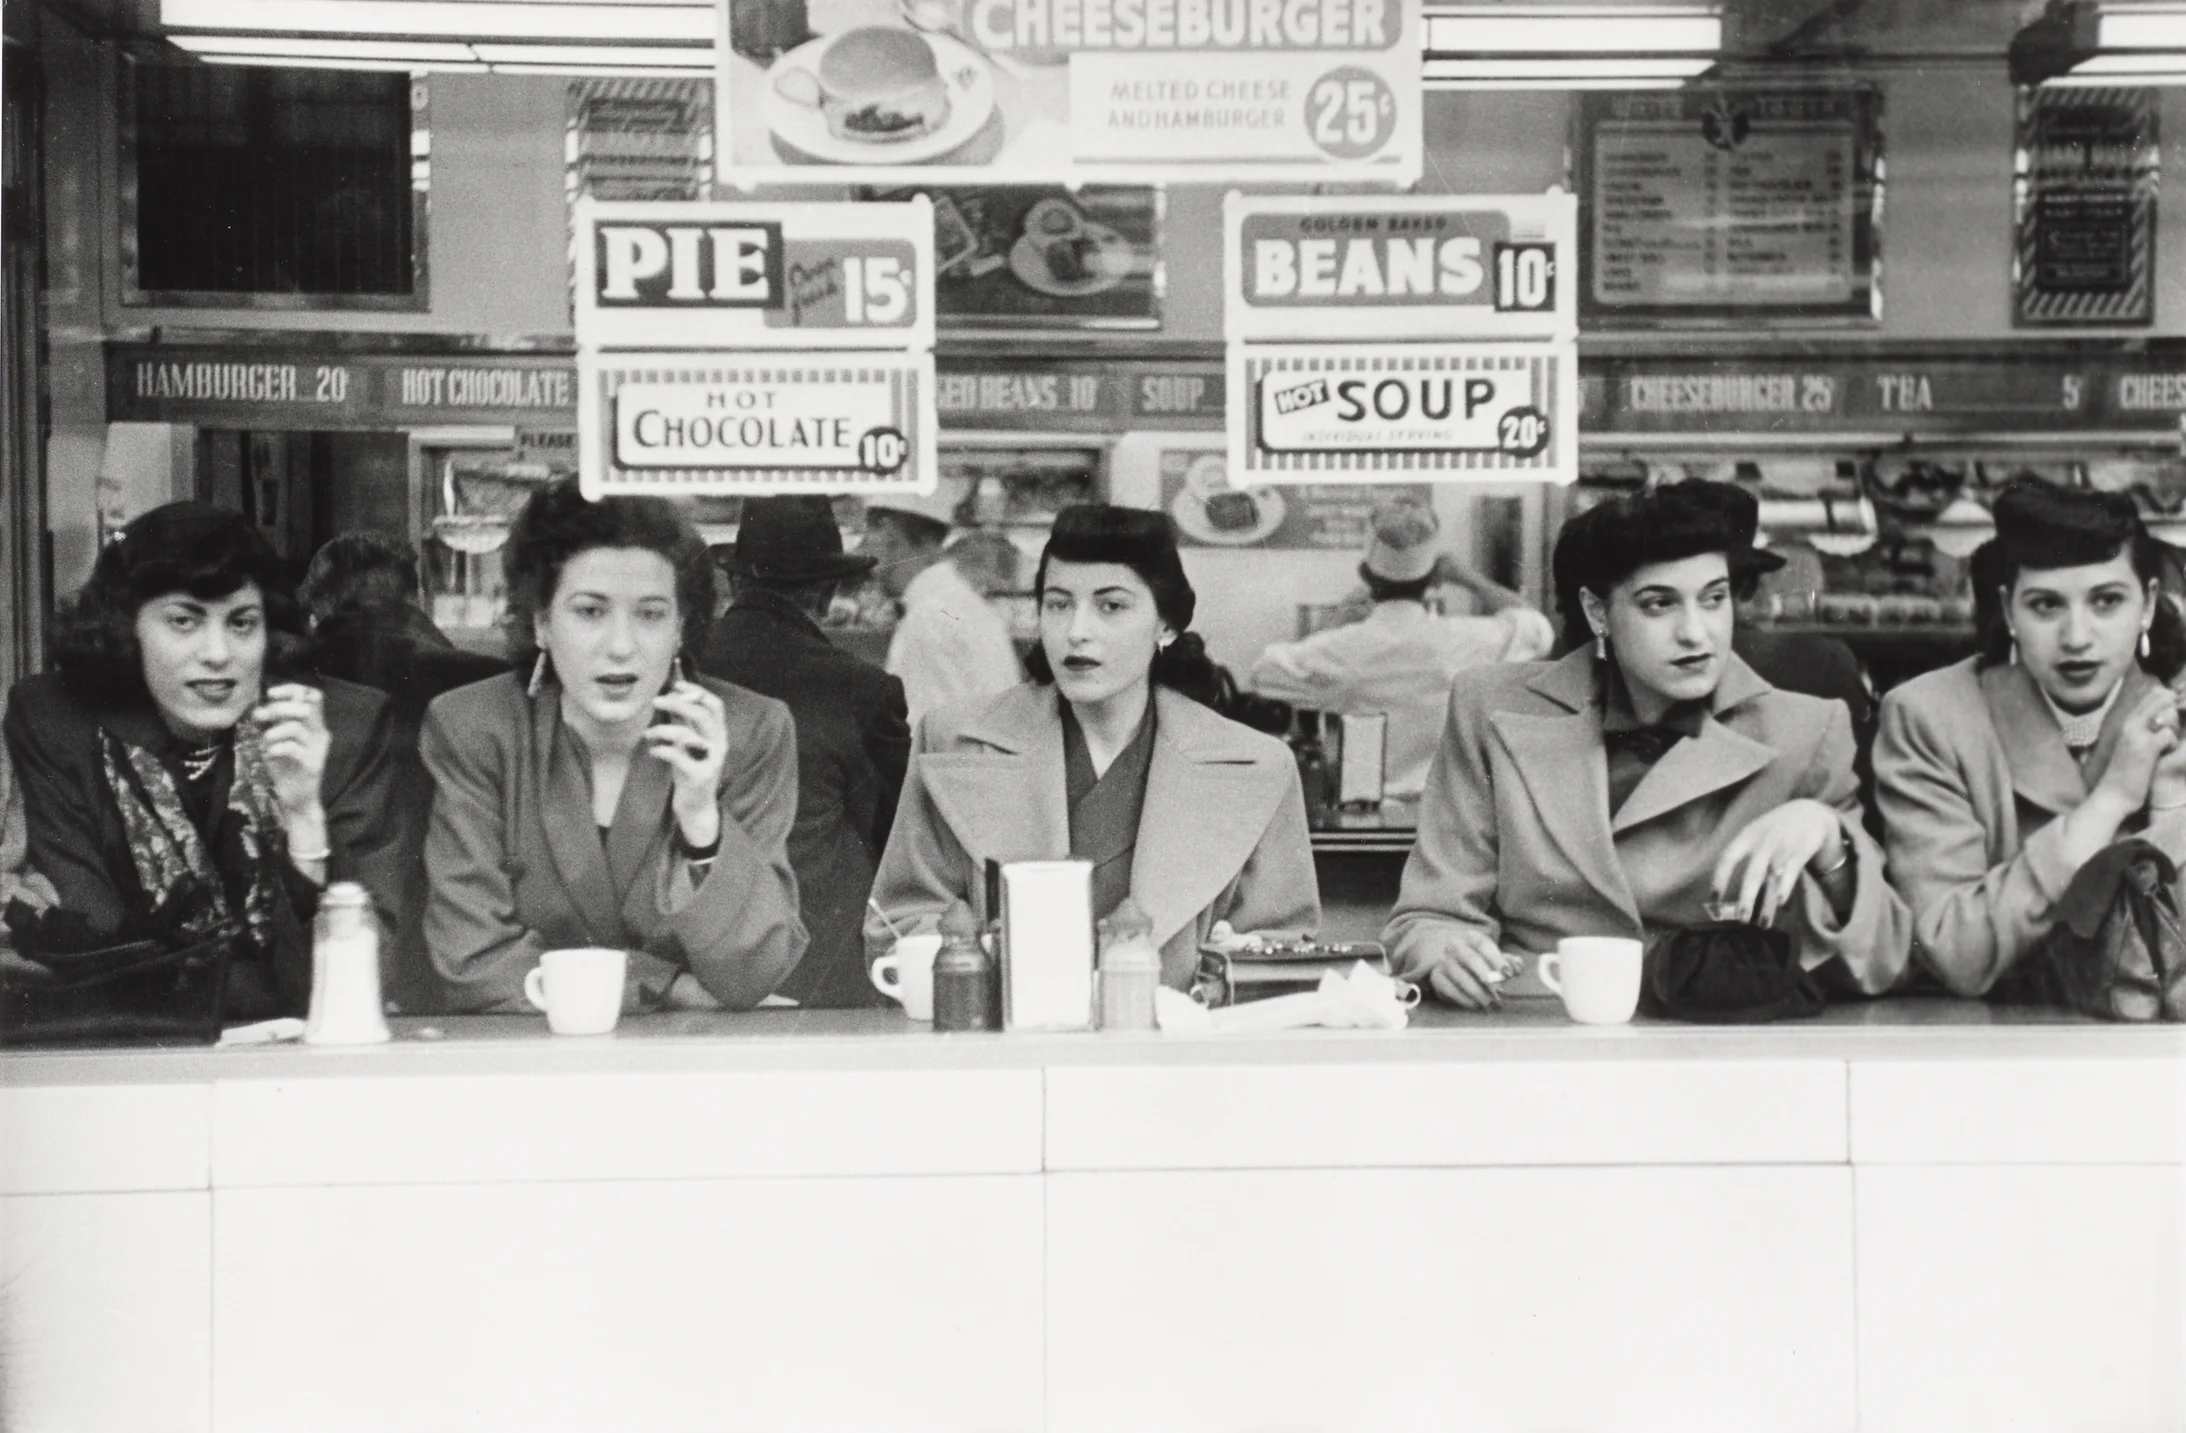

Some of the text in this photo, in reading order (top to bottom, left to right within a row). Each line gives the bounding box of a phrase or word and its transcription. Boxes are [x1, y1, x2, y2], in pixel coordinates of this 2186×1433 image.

[971, 0, 1387, 48] CHEESEBURGER
[1110, 78, 1291, 101] MELTED CHEESE
[599, 226, 770, 300] PIE
[1254, 236, 1485, 297] BEANS
[136, 362, 297, 402] HAMBURGER
[402, 368, 570, 407] HOT CHOCOLATE
[706, 391, 779, 409] HOT
[1276, 377, 1497, 423] HOT SOUP
[1629, 373, 1796, 412] CHEESEBURGER
[1875, 373, 1933, 412] TEA
[632, 409, 852, 449] CHOCOLATE
